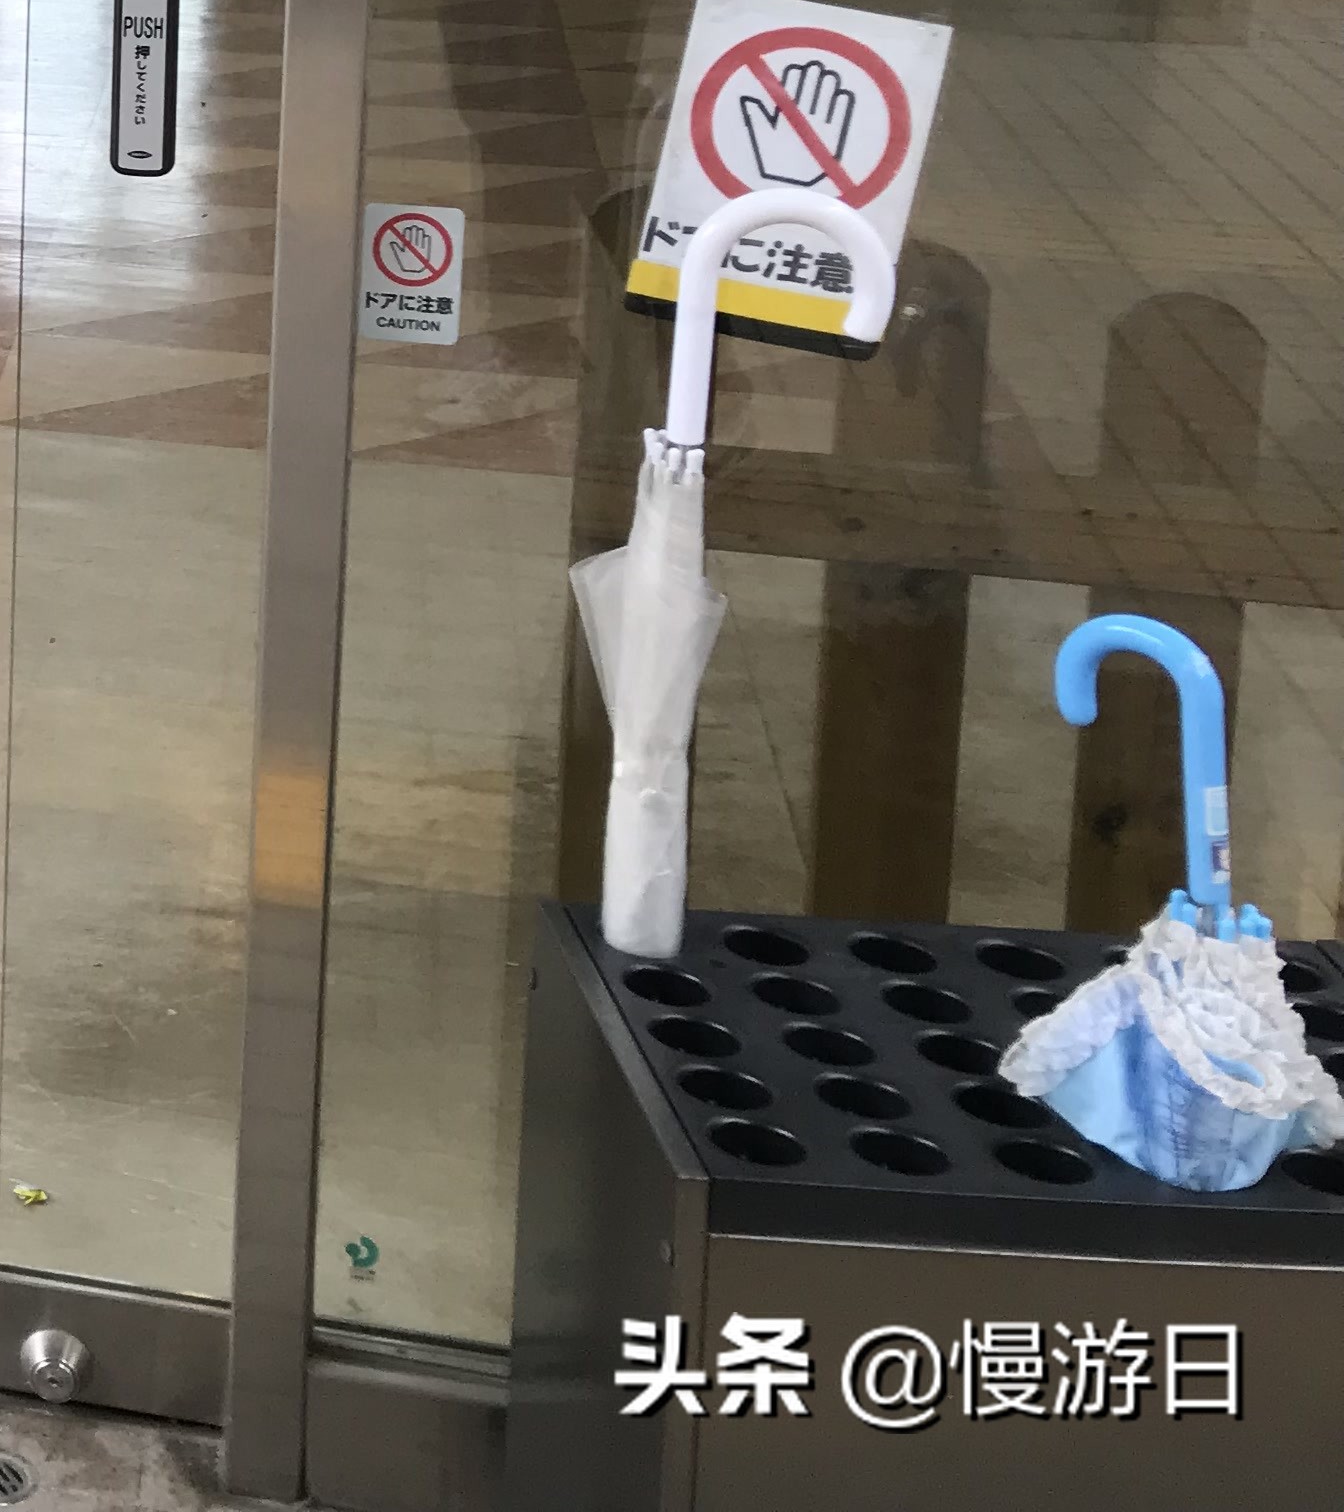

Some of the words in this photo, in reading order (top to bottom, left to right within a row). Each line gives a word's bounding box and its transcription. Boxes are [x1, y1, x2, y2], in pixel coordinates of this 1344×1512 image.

[123, 16, 165, 39] PUSH
[134, 45, 151, 126] 押してください
[643, 215, 854, 294] ドに注意
[364, 290, 454, 316] ドアに注意
[375, 317, 442, 332] CAUTION
